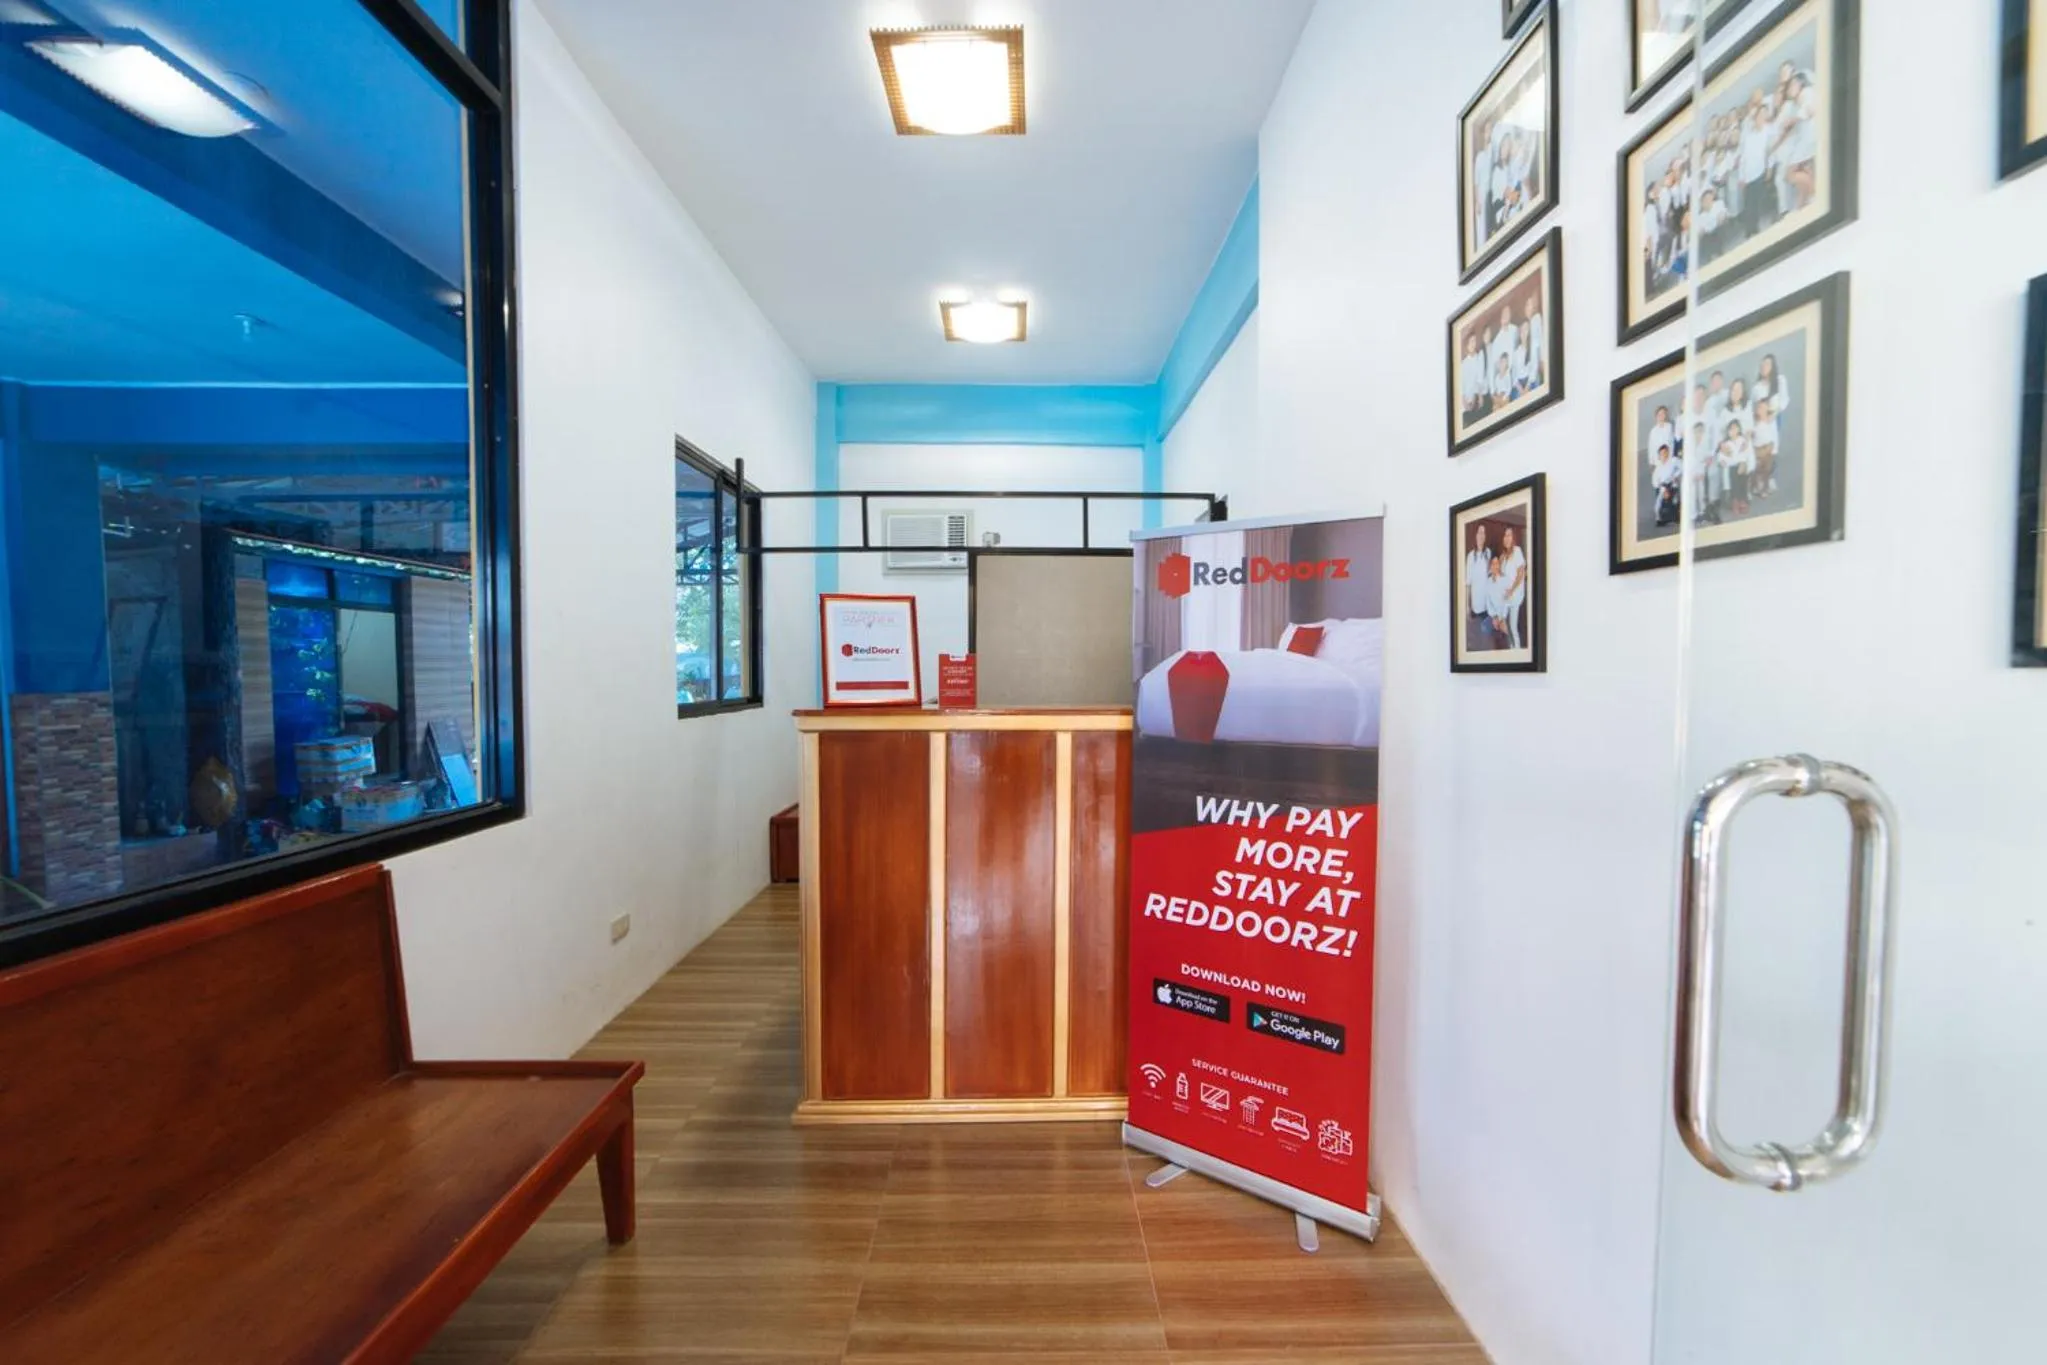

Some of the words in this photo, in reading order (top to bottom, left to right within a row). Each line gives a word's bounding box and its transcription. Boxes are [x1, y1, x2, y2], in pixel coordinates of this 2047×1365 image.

[1193, 556, 1351, 586] RedDoorz
[1196, 795, 1280, 829] WHY
[1285, 806, 1364, 839] PAY
[1234, 837, 1355, 884] MORE,
[1211, 870, 1302, 907] STAY
[1304, 887, 1362, 918] AT
[1144, 892, 1359, 958] REDDOORZ!
[1181, 963, 1262, 993] DOWNLOAD
[1264, 983, 1306, 1005] NOW!
[1175, 996, 1194, 1009] App
[1194, 1000, 1217, 1014] Store
[1271, 1010, 1283, 1019] GET
[1289, 1015, 1300, 1024] ON
[1269, 1018, 1312, 1041] Google
[1312, 1029, 1341, 1050] Play
[1191, 1058, 1229, 1077] SERVICE
[1230, 1070, 1289, 1097] GUARANTEE
